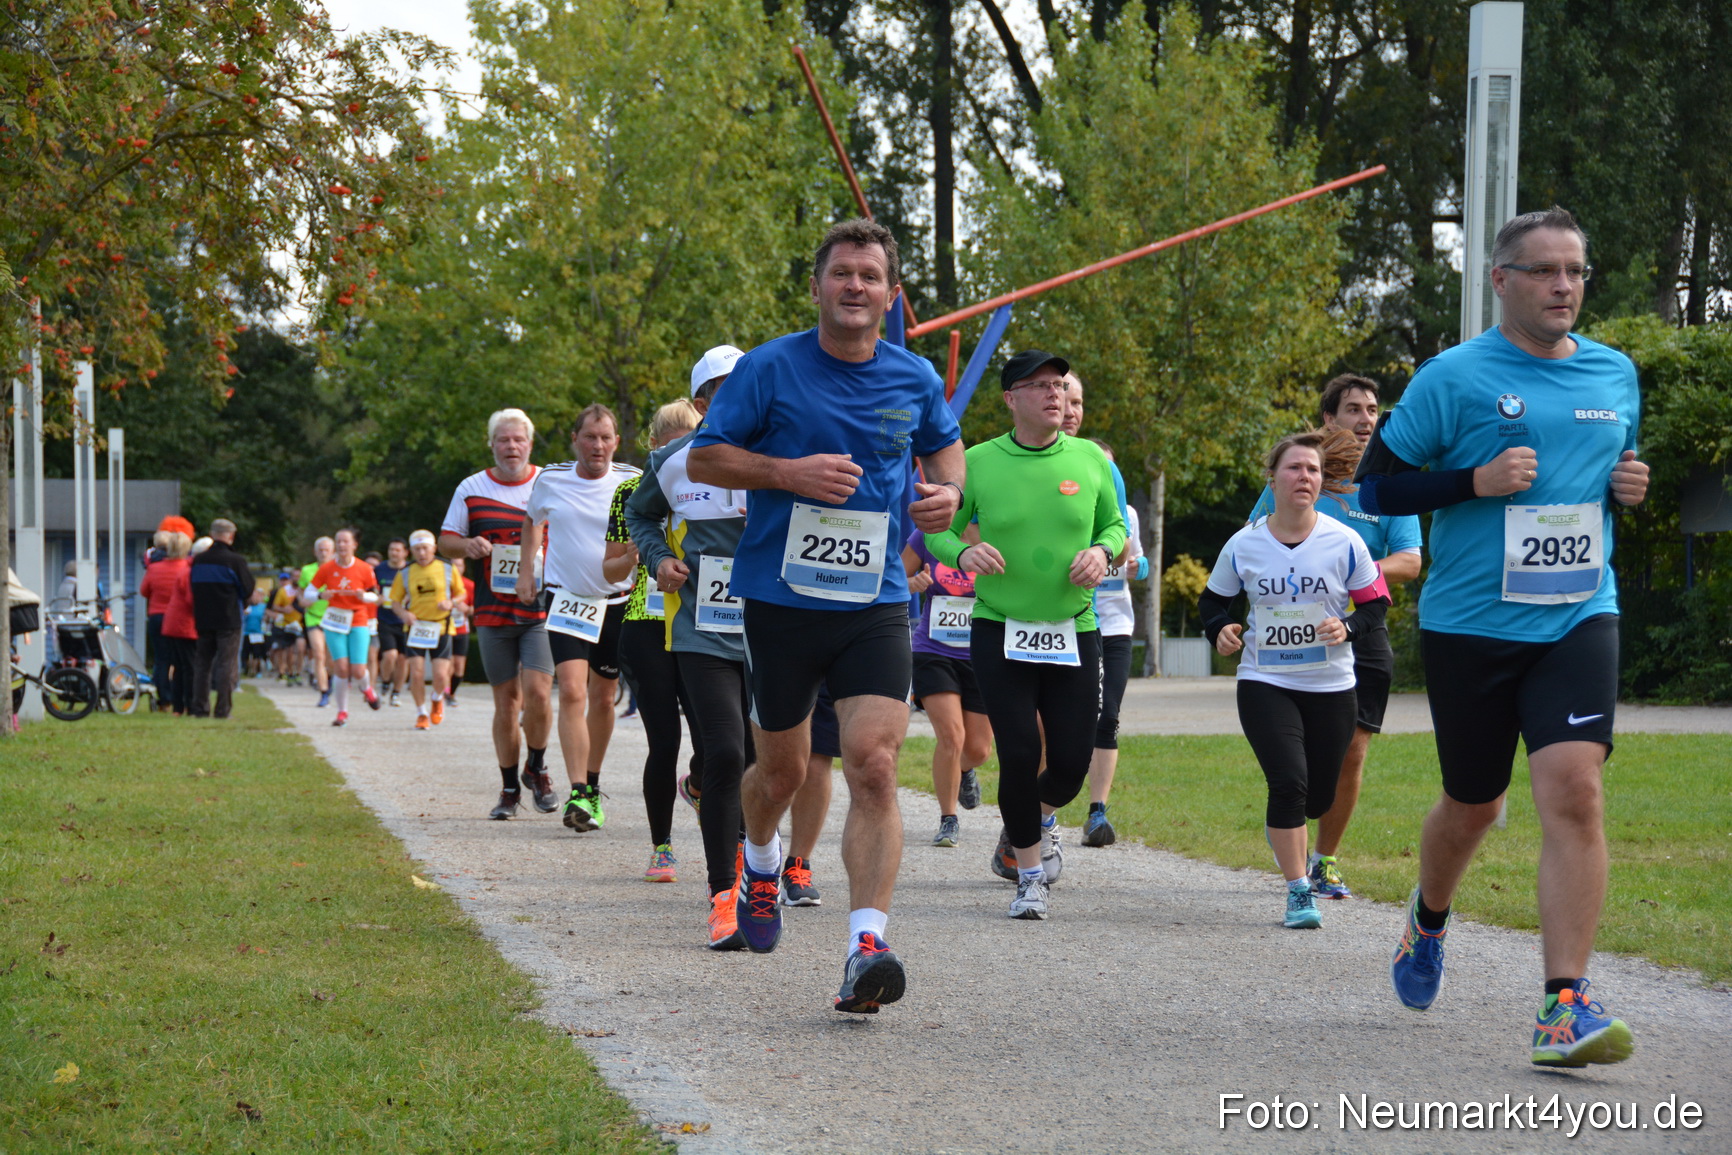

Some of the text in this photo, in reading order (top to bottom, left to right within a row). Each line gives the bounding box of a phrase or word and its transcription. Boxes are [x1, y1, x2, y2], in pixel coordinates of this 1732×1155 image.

[1574, 409, 1618, 421] BOCK
[1498, 423, 1528, 431] PARTL
[1348, 510, 1379, 522] BOCK
[1549, 514, 1580, 523] BOCK
[829, 518, 861, 527] BOCK
[800, 534, 870, 567] 2235
[1522, 534, 1590, 566] 2932
[815, 572, 849, 584] Hubert
[1258, 572, 1329, 598] SUSPA
[559, 600, 597, 622] 2472
[713, 611, 736, 620] Franz
[565, 619, 584, 629] Werner
[1015, 630, 1066, 650] 2493
[1266, 624, 1316, 646] 2069
[1280, 652, 1303, 660] Karina
